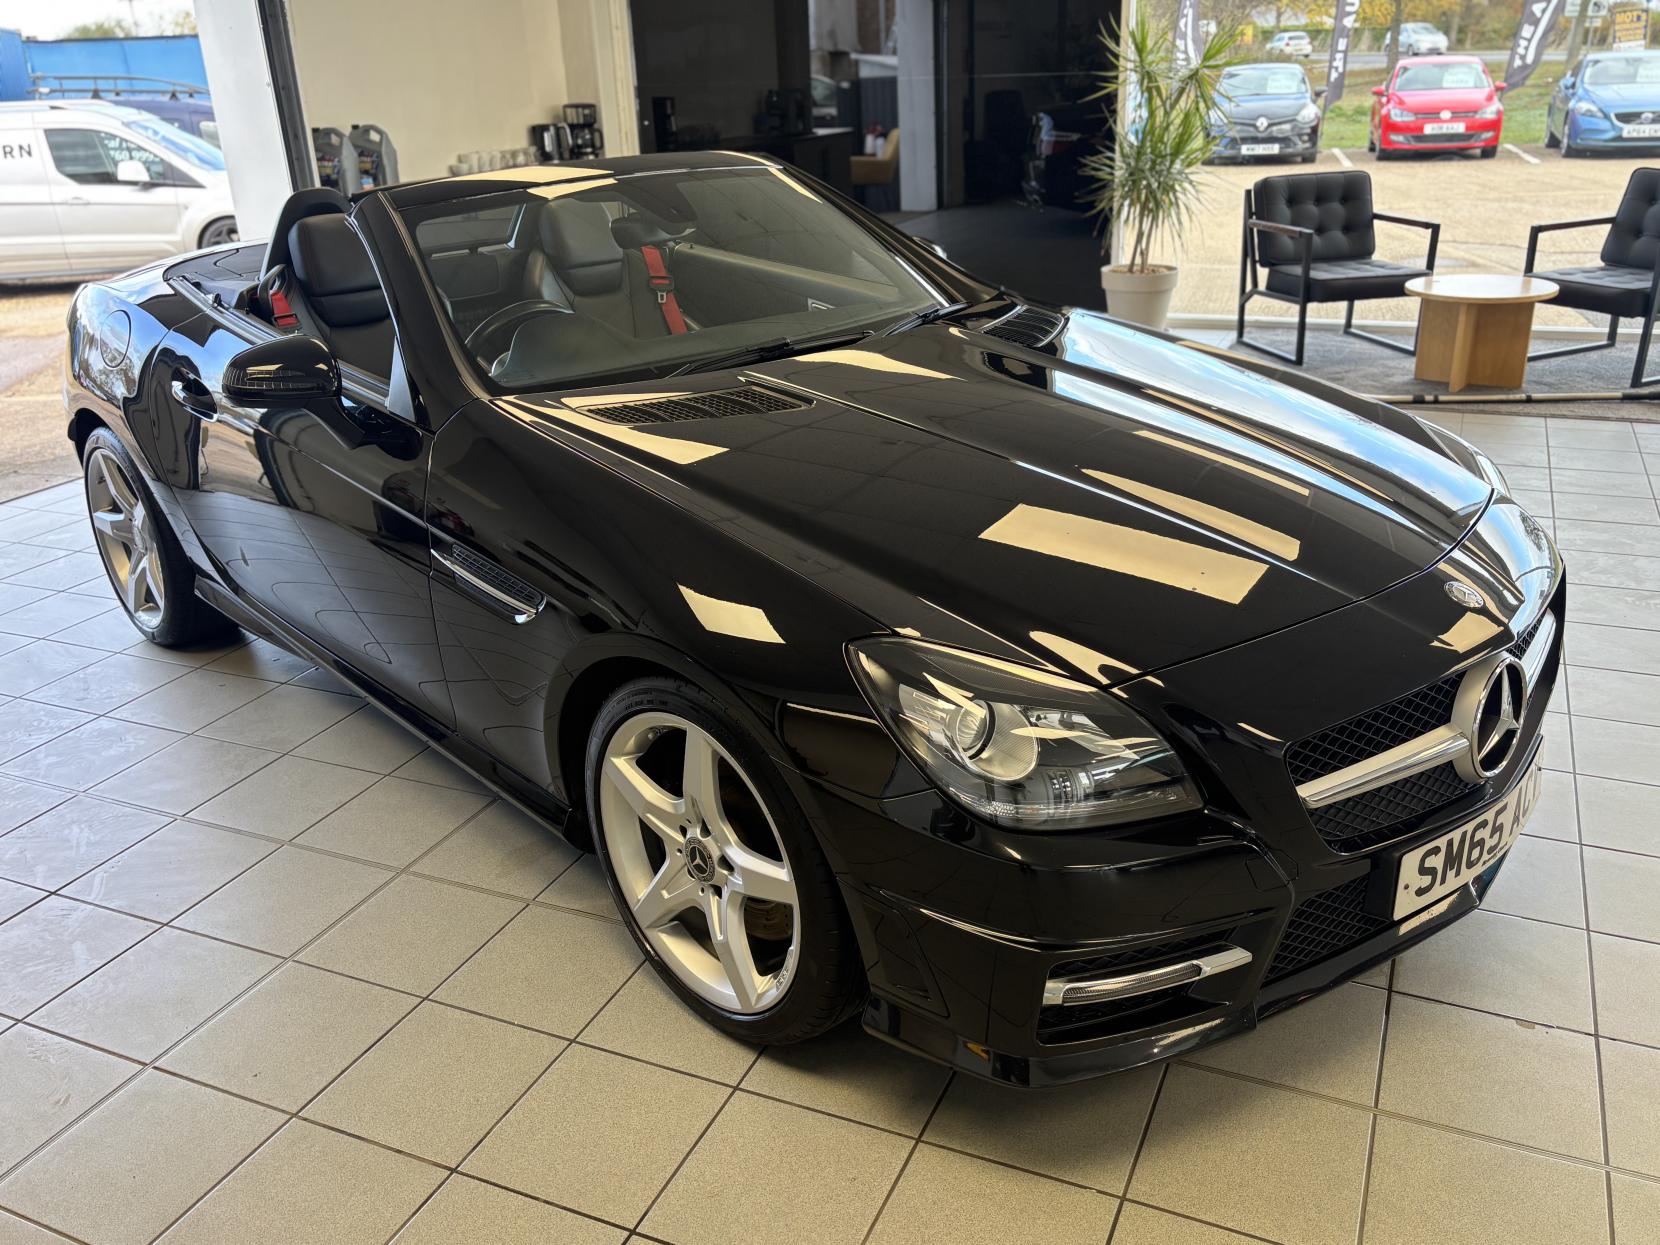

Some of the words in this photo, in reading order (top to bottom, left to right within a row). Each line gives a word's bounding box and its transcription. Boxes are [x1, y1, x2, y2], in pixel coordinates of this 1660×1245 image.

[1330, 38, 1348, 82] THE
[1513, 23, 1535, 69] THE
[2, 144, 33, 159] RN
[1414, 800, 1509, 898] SM65
